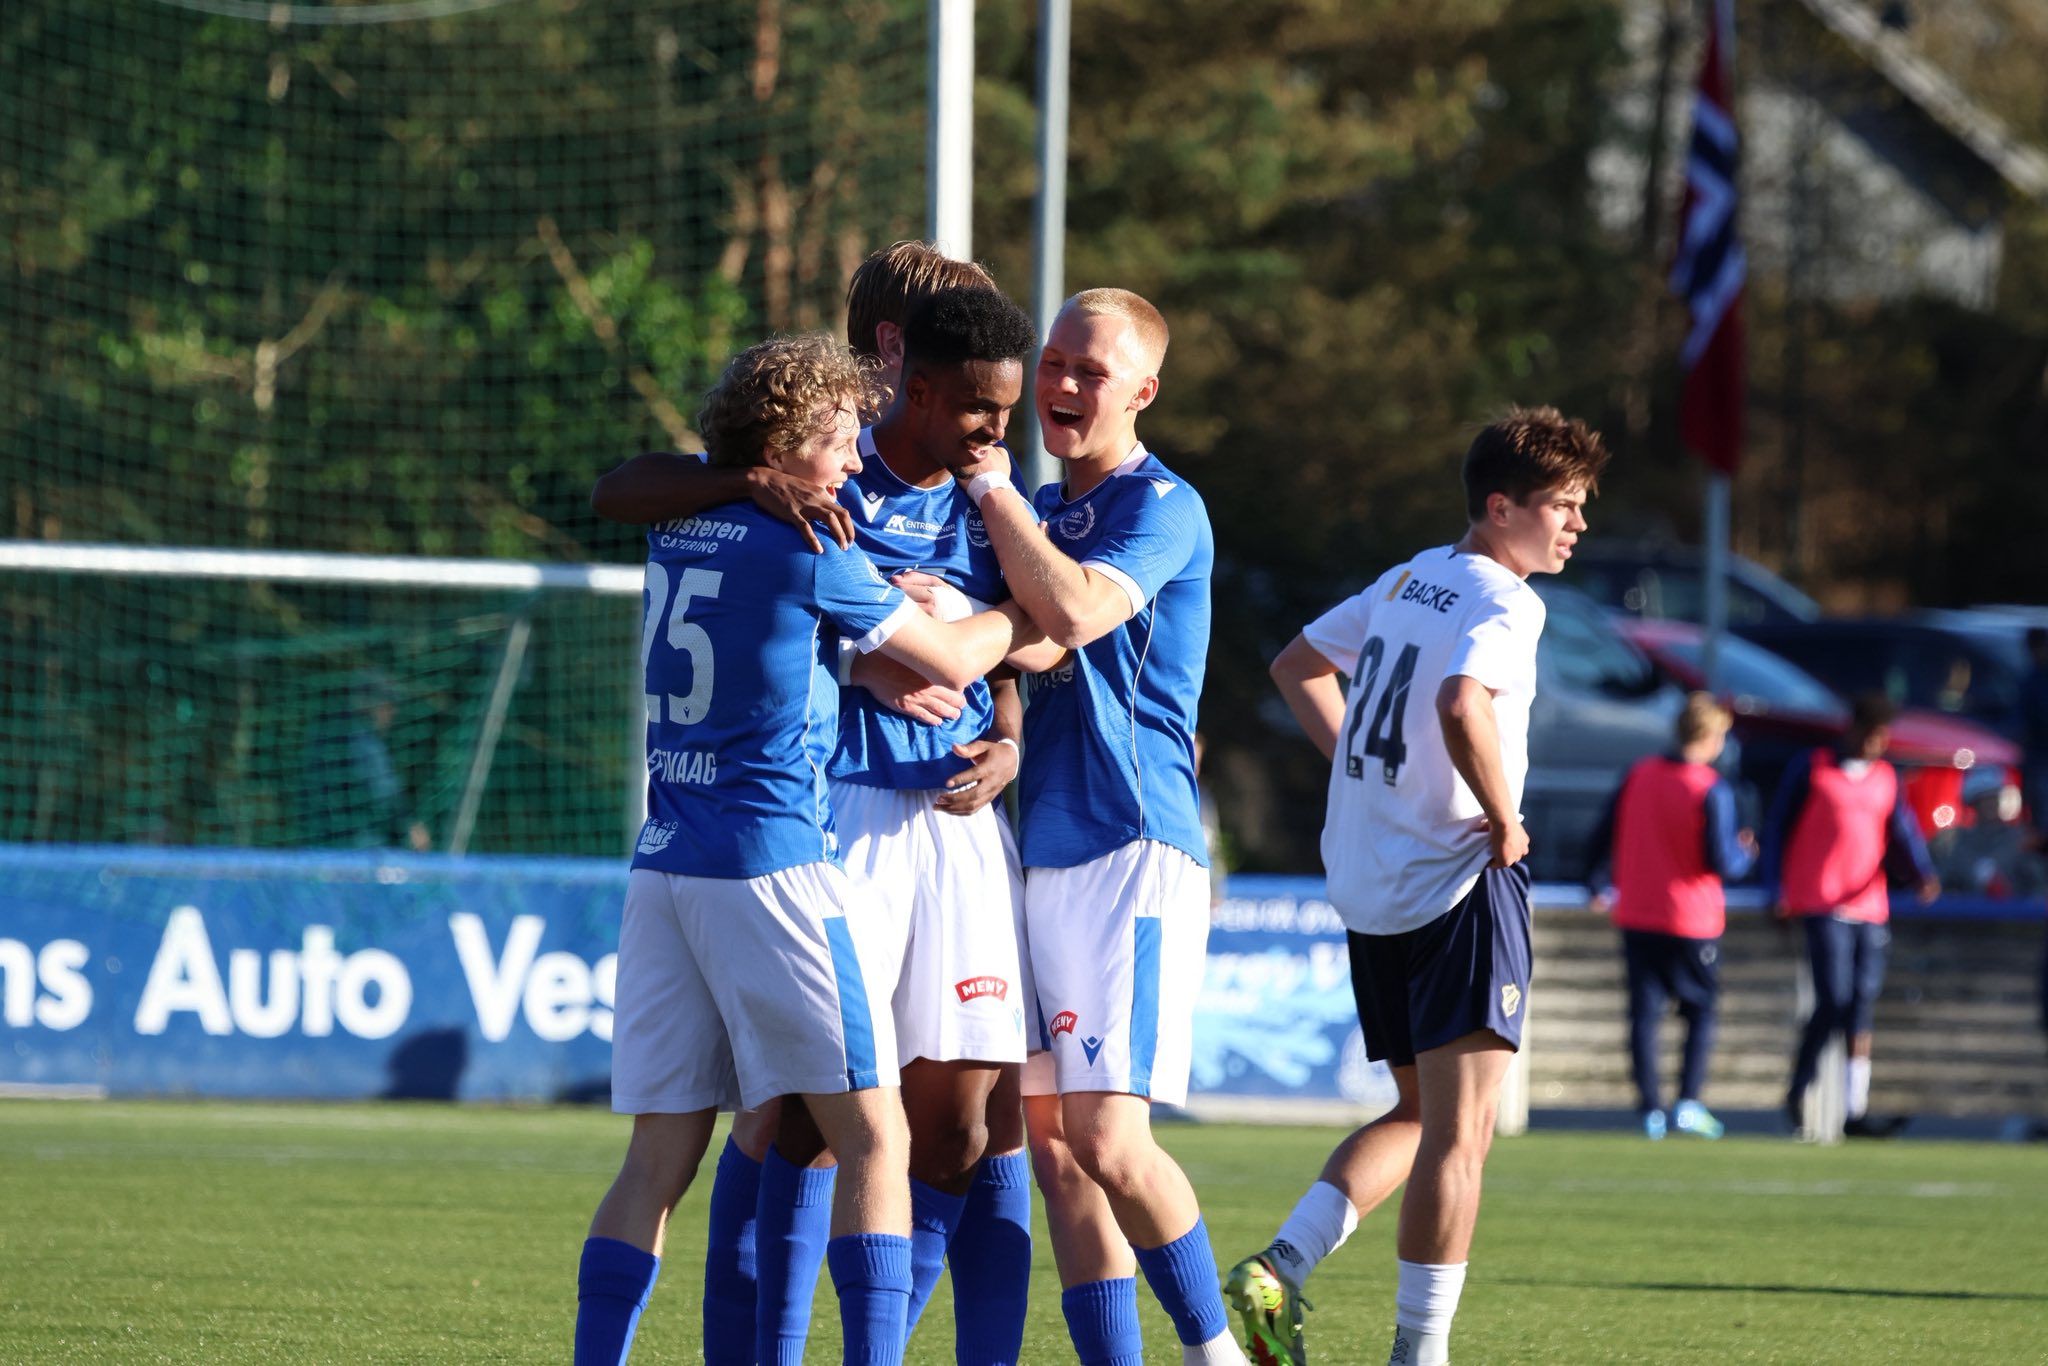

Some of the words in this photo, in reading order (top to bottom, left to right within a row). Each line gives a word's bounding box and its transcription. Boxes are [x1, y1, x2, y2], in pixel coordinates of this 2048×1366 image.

[969, 519, 984, 527] FLØ
[660, 534, 719, 554] CATERING
[1401, 579, 1460, 614] BACKE
[641, 561, 724, 726] 25
[1346, 634, 1422, 788] 24
[134, 905, 413, 1039] Auto
[961, 979, 1005, 997] MENY
[1051, 1015, 1073, 1033] MENY
